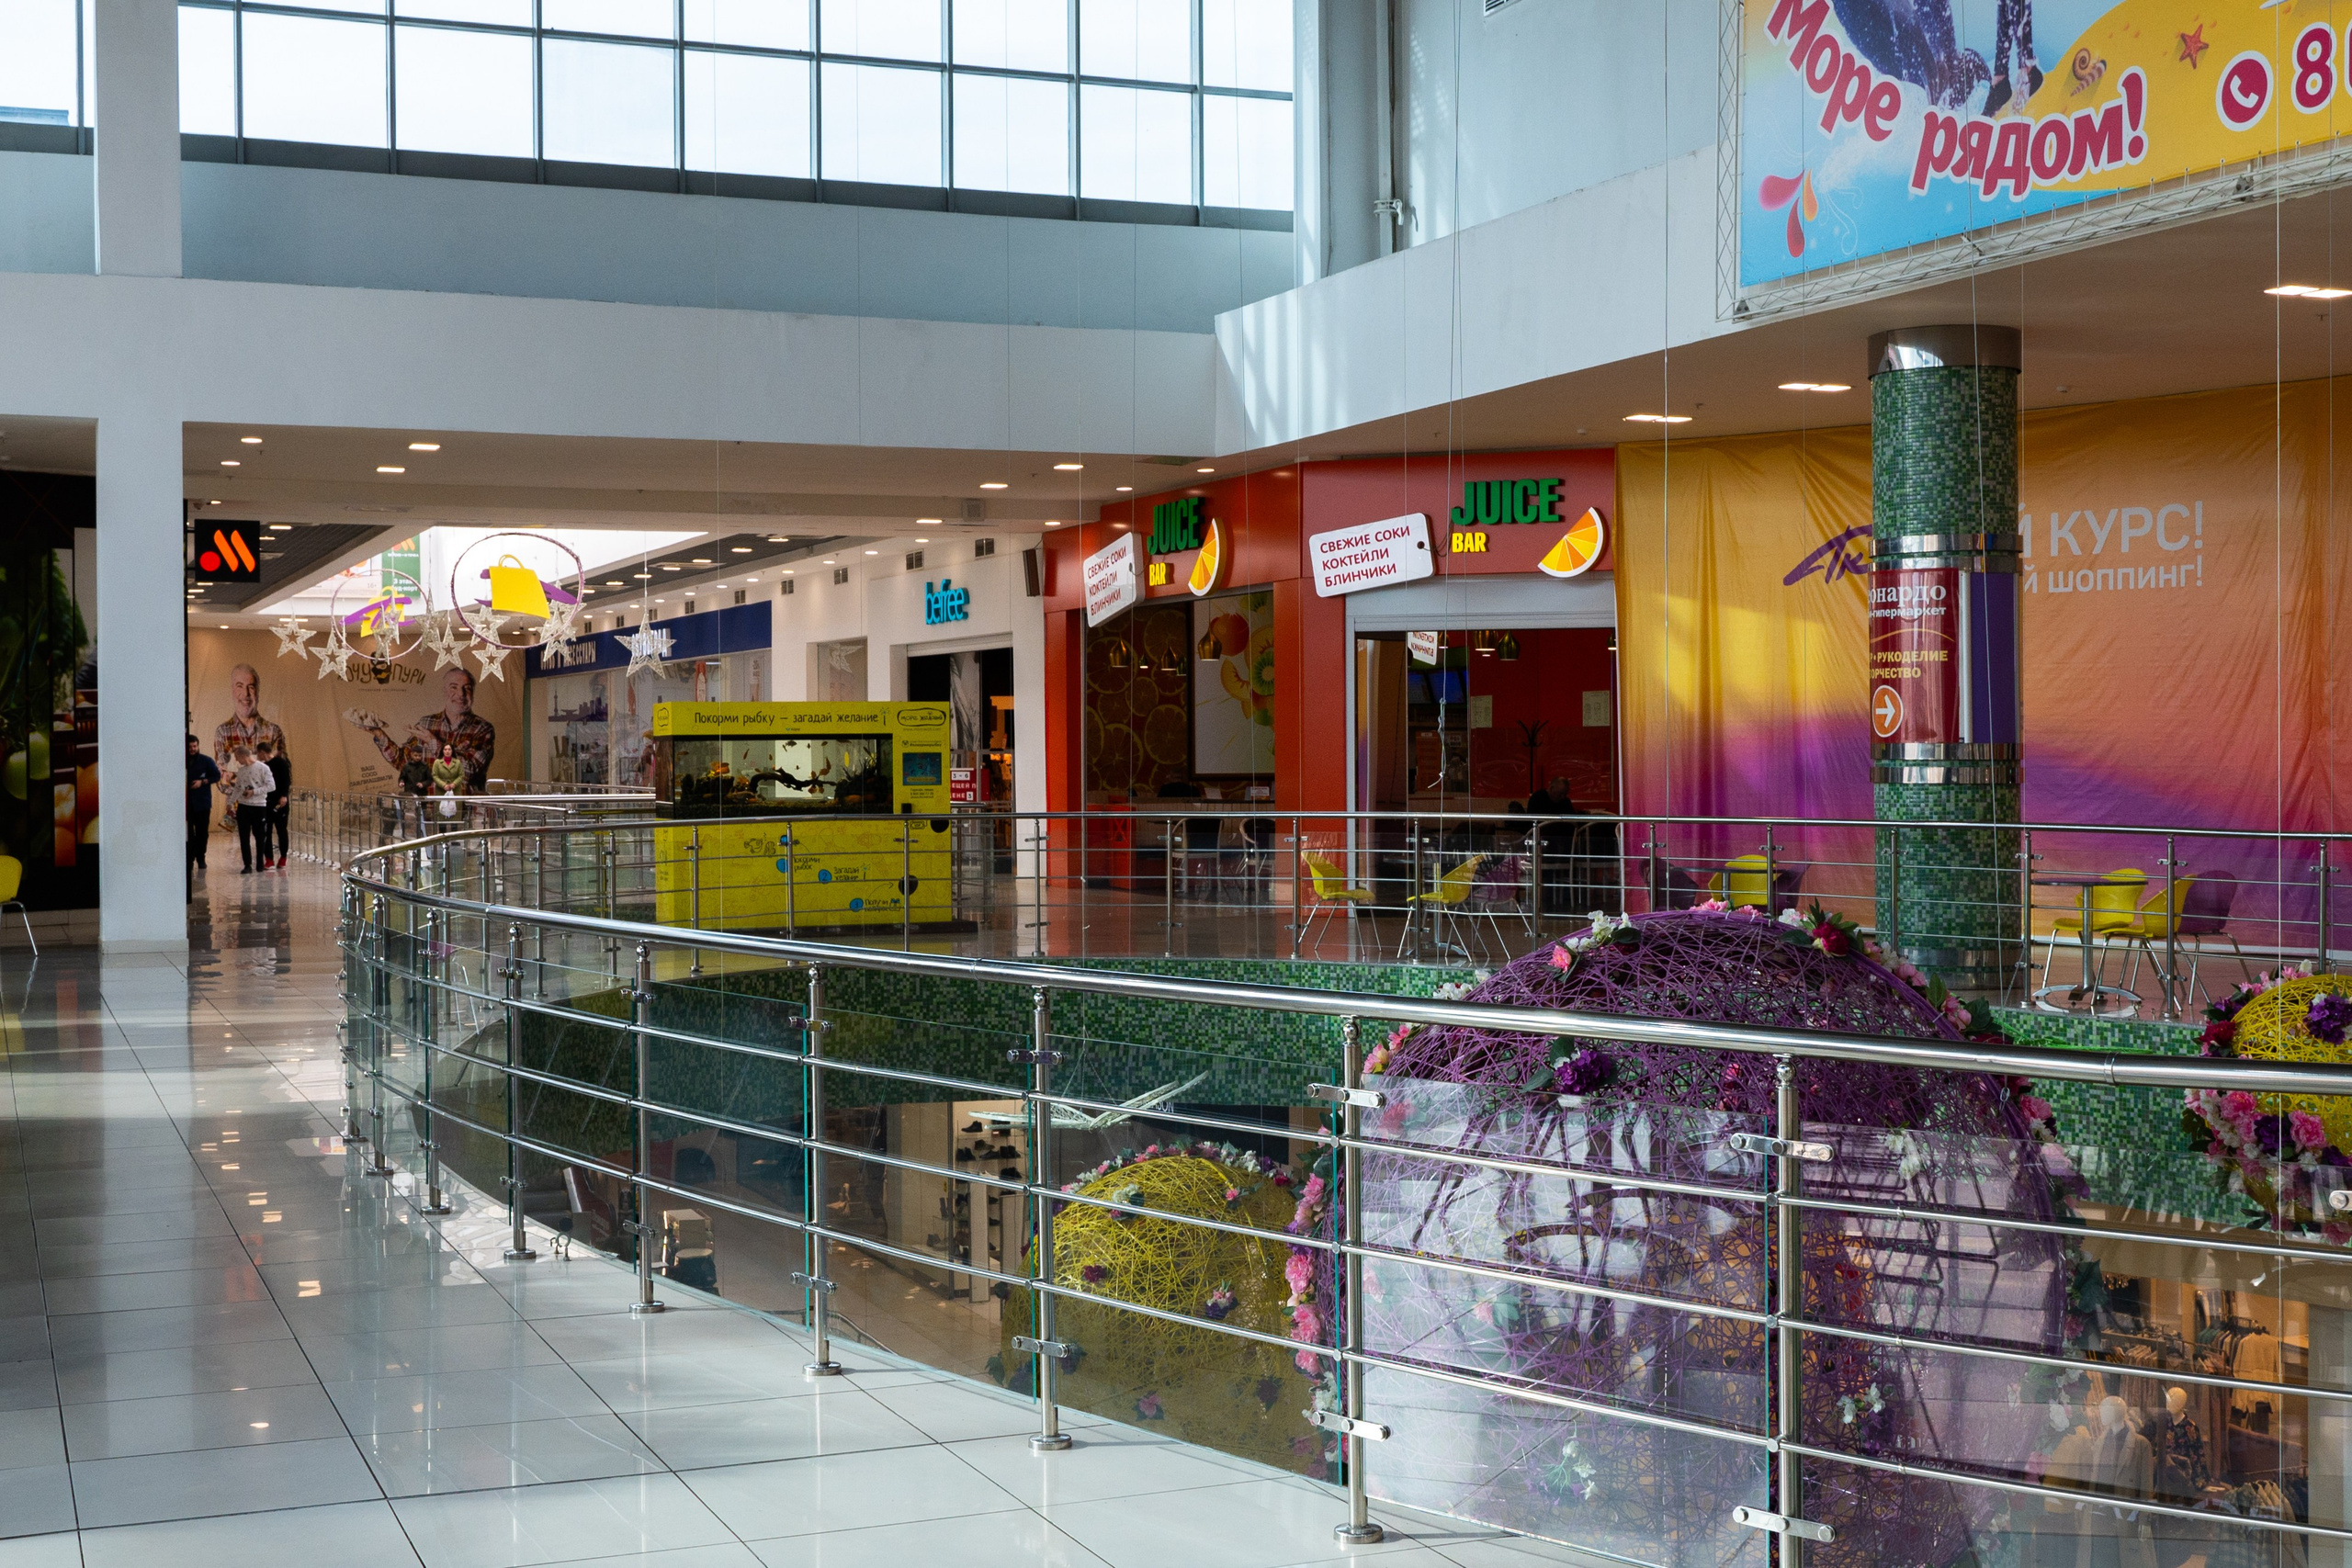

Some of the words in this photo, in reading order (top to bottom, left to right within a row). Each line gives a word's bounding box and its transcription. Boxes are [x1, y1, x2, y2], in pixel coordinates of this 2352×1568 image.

[1768, 0, 1901, 141] Море
[1912, 71, 2147, 197] рядом!
[1451, 478, 1560, 526] JUICE
[1148, 497, 1199, 555] JUICE
[2050, 501, 2203, 557] КУРС!
[1319, 534, 1371, 554] СВЕЖИЕ
[1374, 525, 1410, 543] СОКИ
[1452, 532, 1487, 553] BAR
[1087, 557, 1110, 580] СВЕЖИЕ
[1110, 546, 1127, 564] СОКИ
[1321, 547, 1390, 571] КОКТЕЙЛИ
[1088, 570, 1118, 596] КОКТЕЙЛИ
[1148, 562, 1167, 587] BAR
[1324, 563, 1396, 588] БЛИНЧИКИ
[2048, 555, 2203, 592] ШОППИНГ!
[925, 579, 966, 625] befree
[1090, 588, 1122, 616] БЛИНЧИКИ
[1869, 585, 1947, 607] онардо
[1877, 650, 1949, 663] РУКОДЕЛИЕ
[337, 663, 371, 683] ОЧУ
[392, 663, 426, 685] ПУРИ
[1870, 668, 1922, 678] ОРЧЕСТВО
[695, 712, 739, 727] Покорми
[743, 711, 775, 727] рыбку
[793, 712, 832, 724] загадай
[837, 713, 879, 724] желание
[833, 866, 860, 875] Загадай
